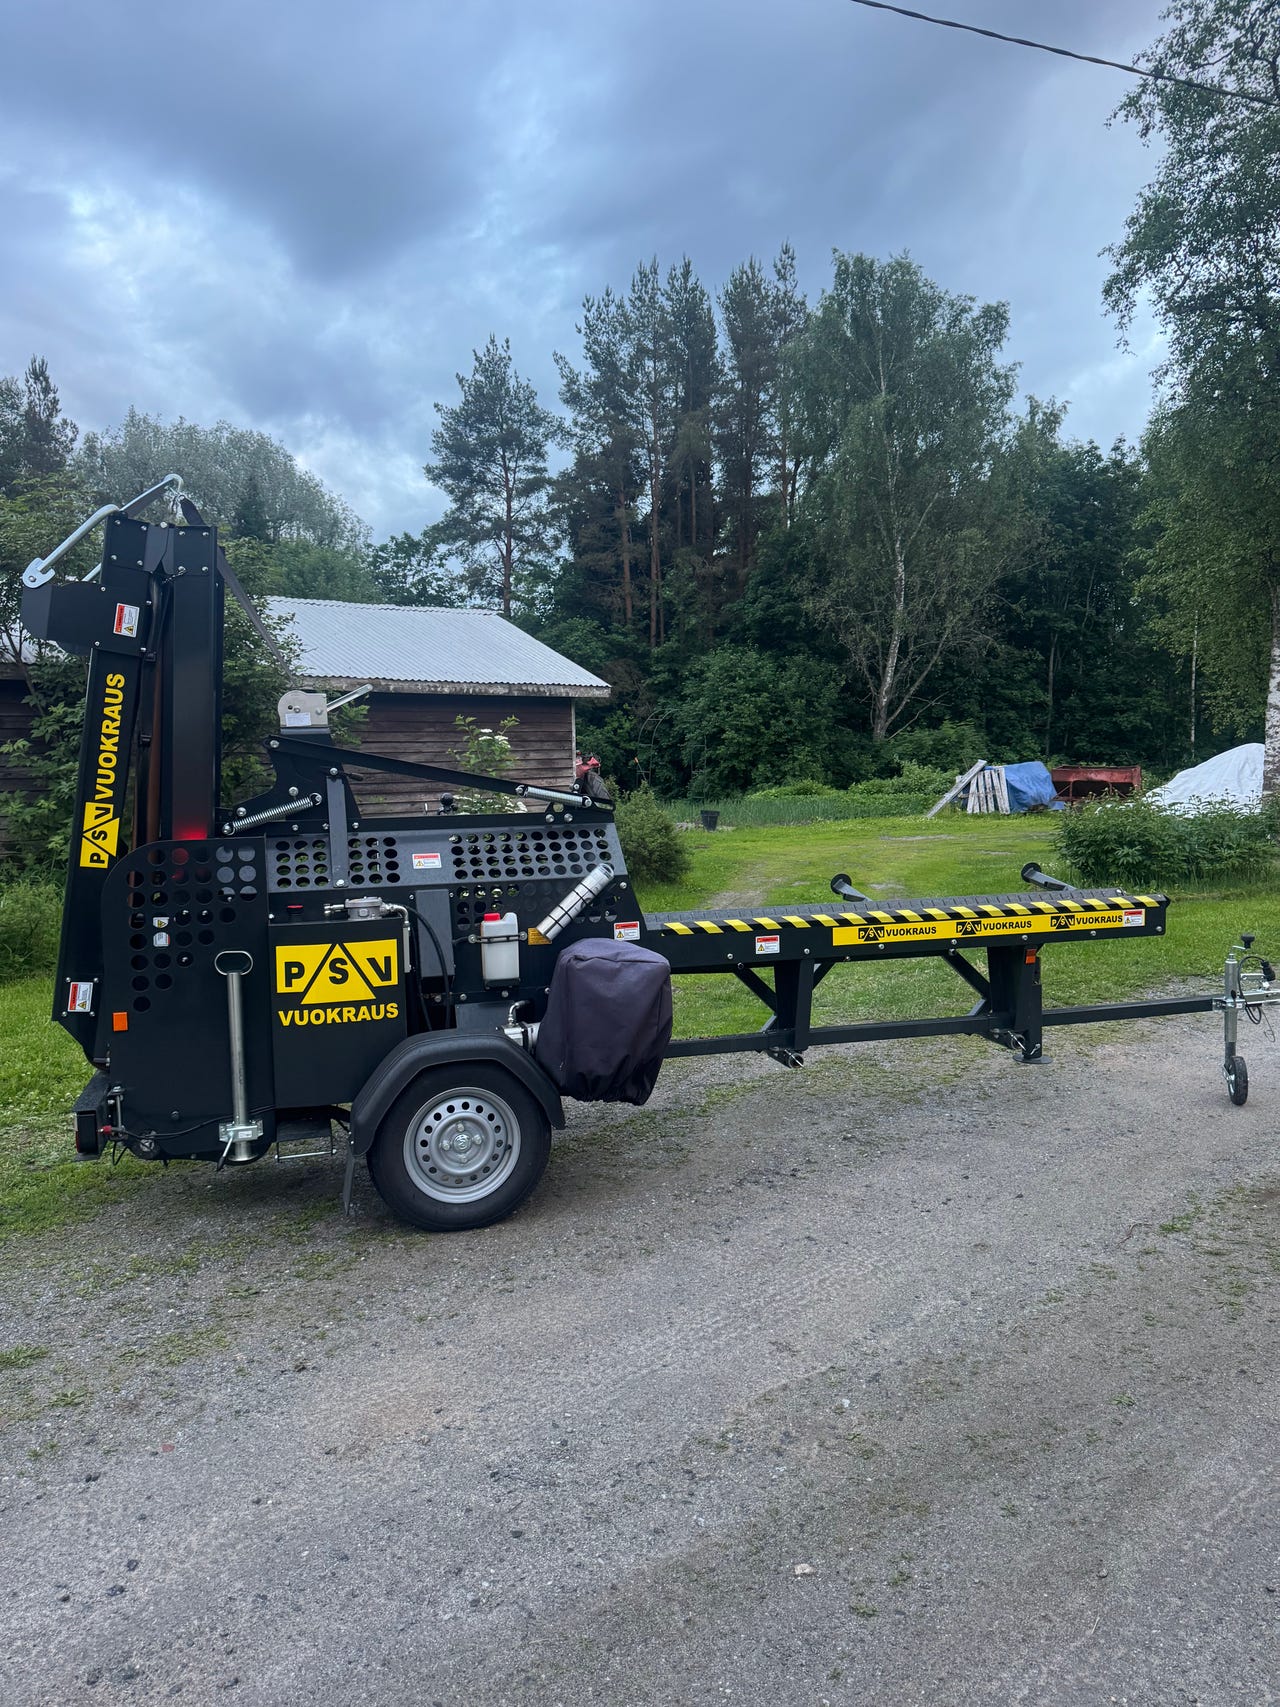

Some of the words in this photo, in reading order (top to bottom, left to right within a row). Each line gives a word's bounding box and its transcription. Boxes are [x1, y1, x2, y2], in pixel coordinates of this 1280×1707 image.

[95, 673, 125, 800] VUOKRAUS
[88, 806, 111, 869] PSV
[859, 927, 884, 939] PSV
[886, 926, 937, 937] VUOKRAUS
[957, 922, 981, 934] PSV
[982, 920, 1032, 931] VUOKRAUS
[1051, 916, 1075, 928] PSV
[1076, 914, 1123, 925] VUOKRAUS
[282, 954, 393, 989] PSV
[278, 1002, 399, 1026] VUOKRAUS
